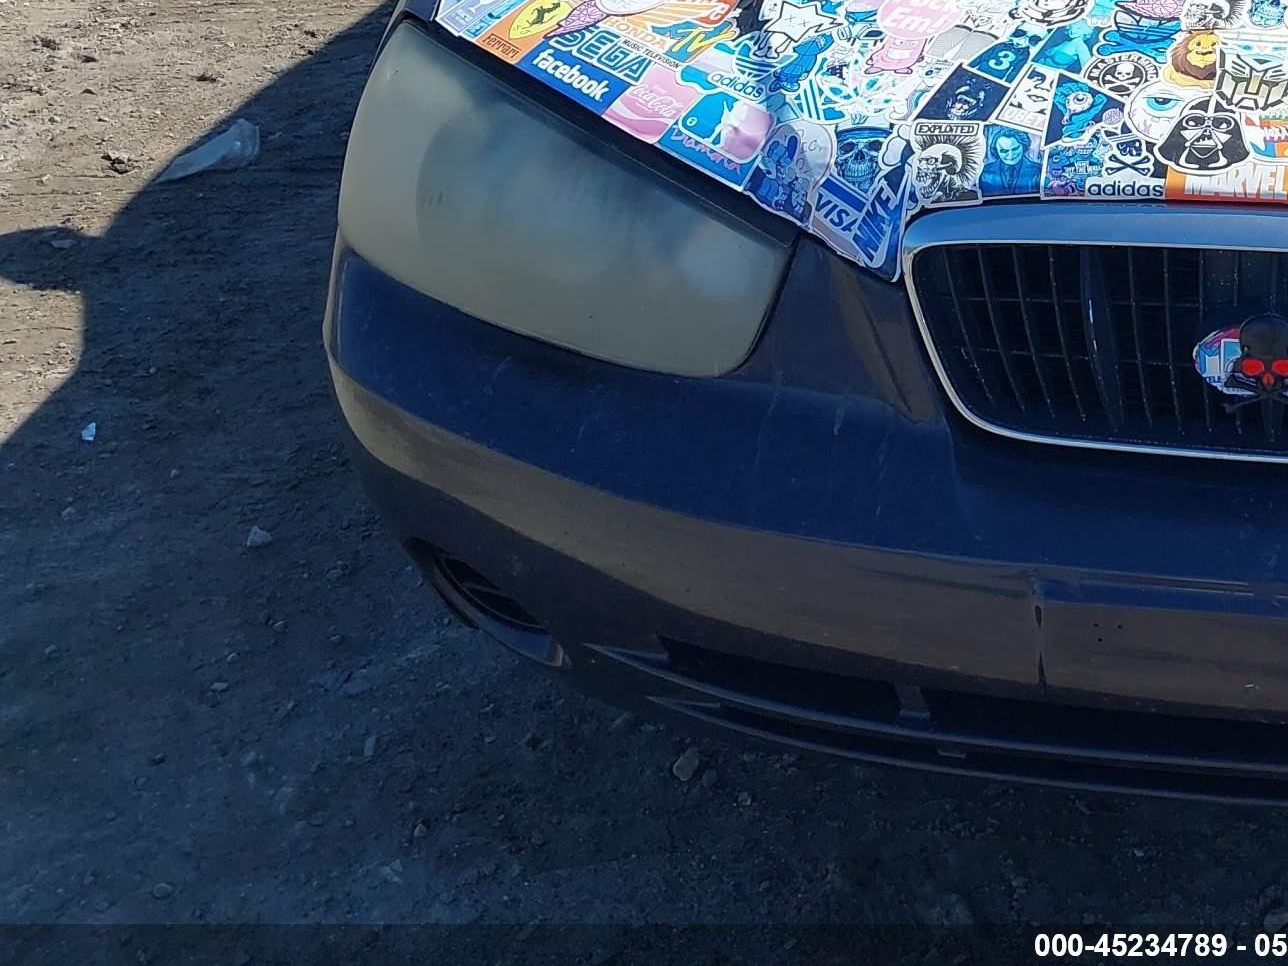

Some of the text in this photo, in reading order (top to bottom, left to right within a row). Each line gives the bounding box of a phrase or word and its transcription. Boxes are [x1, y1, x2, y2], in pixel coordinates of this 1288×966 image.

[482, 33, 522, 59] Ferrari
[603, 16, 668, 50] HONDA
[622, 39, 683, 70] MUSIC TELEVISION
[988, 50, 1016, 71] 3
[532, 48, 611, 102] facebook
[711, 72, 764, 99] adidas
[1087, 180, 1164, 197] adidas
[1184, 164, 1288, 200] MARVEL
[852, 180, 898, 261] NIKE
